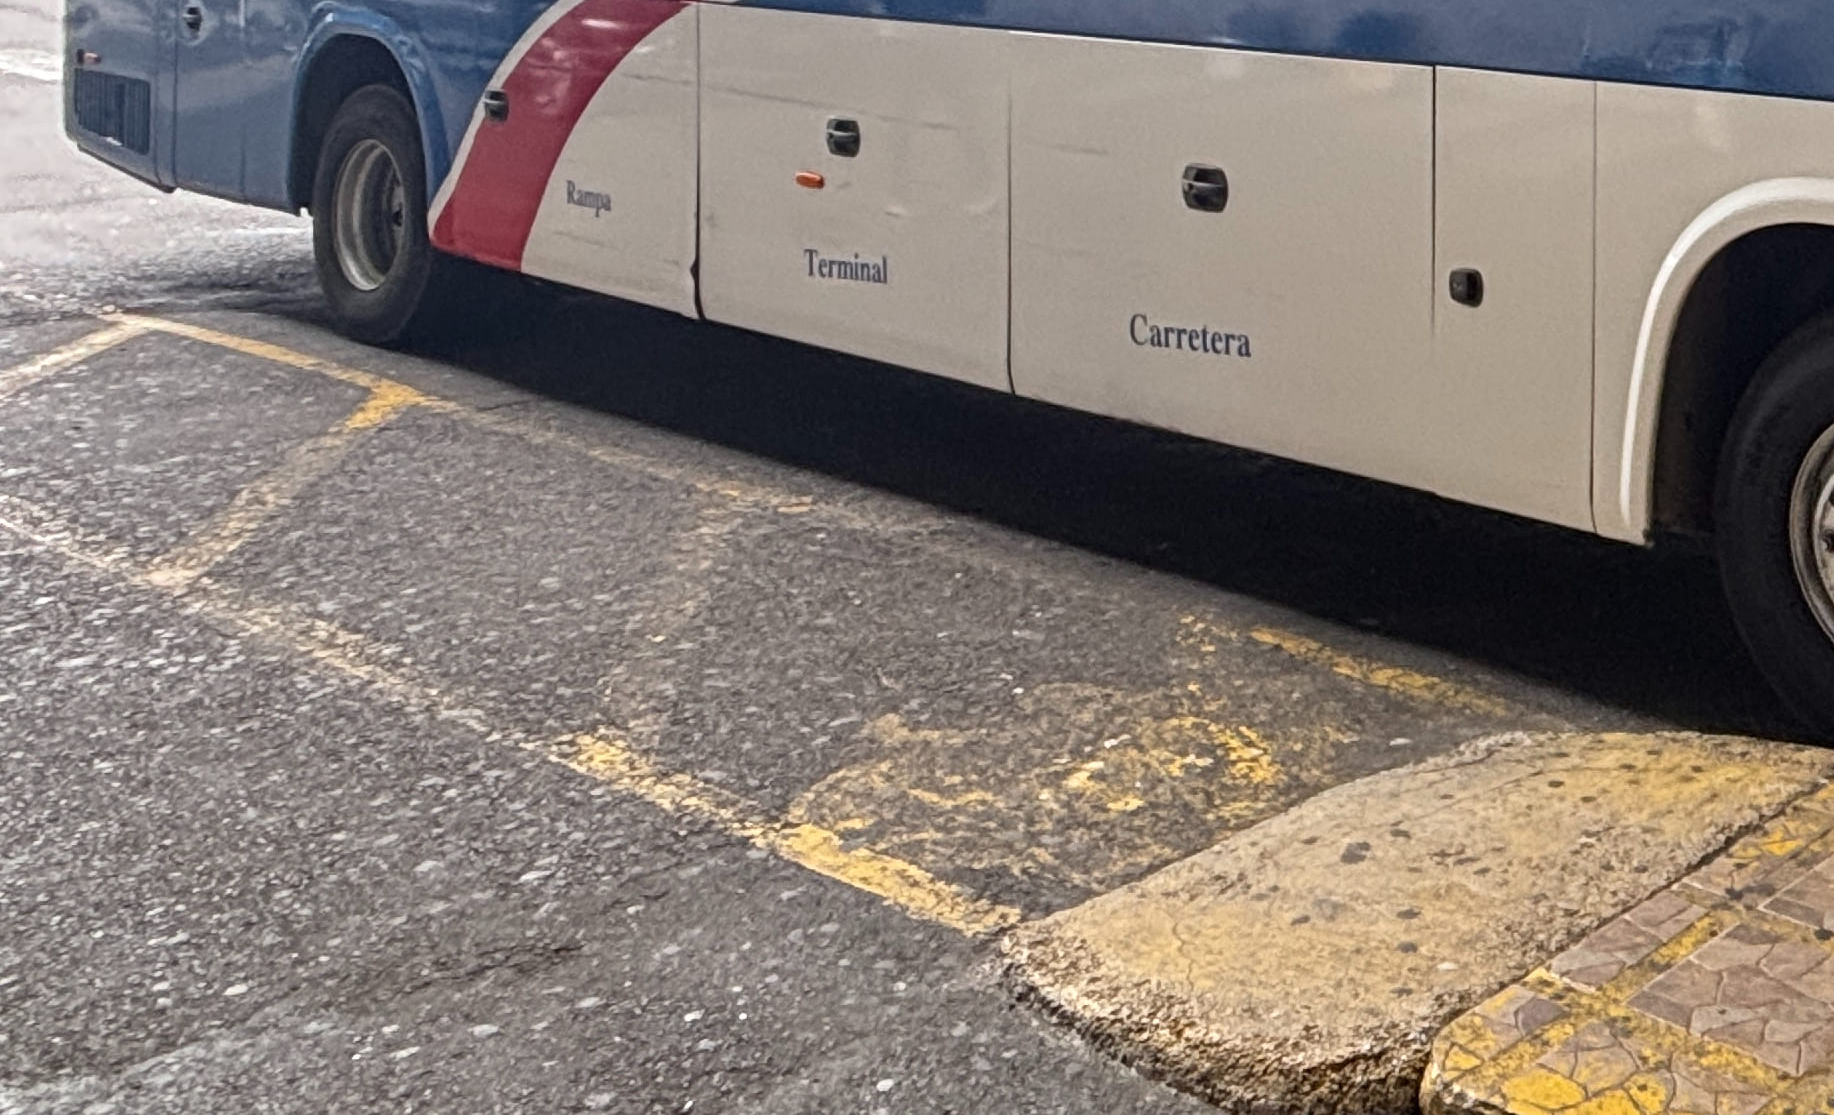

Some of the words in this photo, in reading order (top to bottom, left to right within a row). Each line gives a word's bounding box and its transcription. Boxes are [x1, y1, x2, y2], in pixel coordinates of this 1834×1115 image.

[565, 180, 612, 218] Rampa
[803, 247, 888, 285] Terminal
[1129, 312, 1252, 358] Carretera
